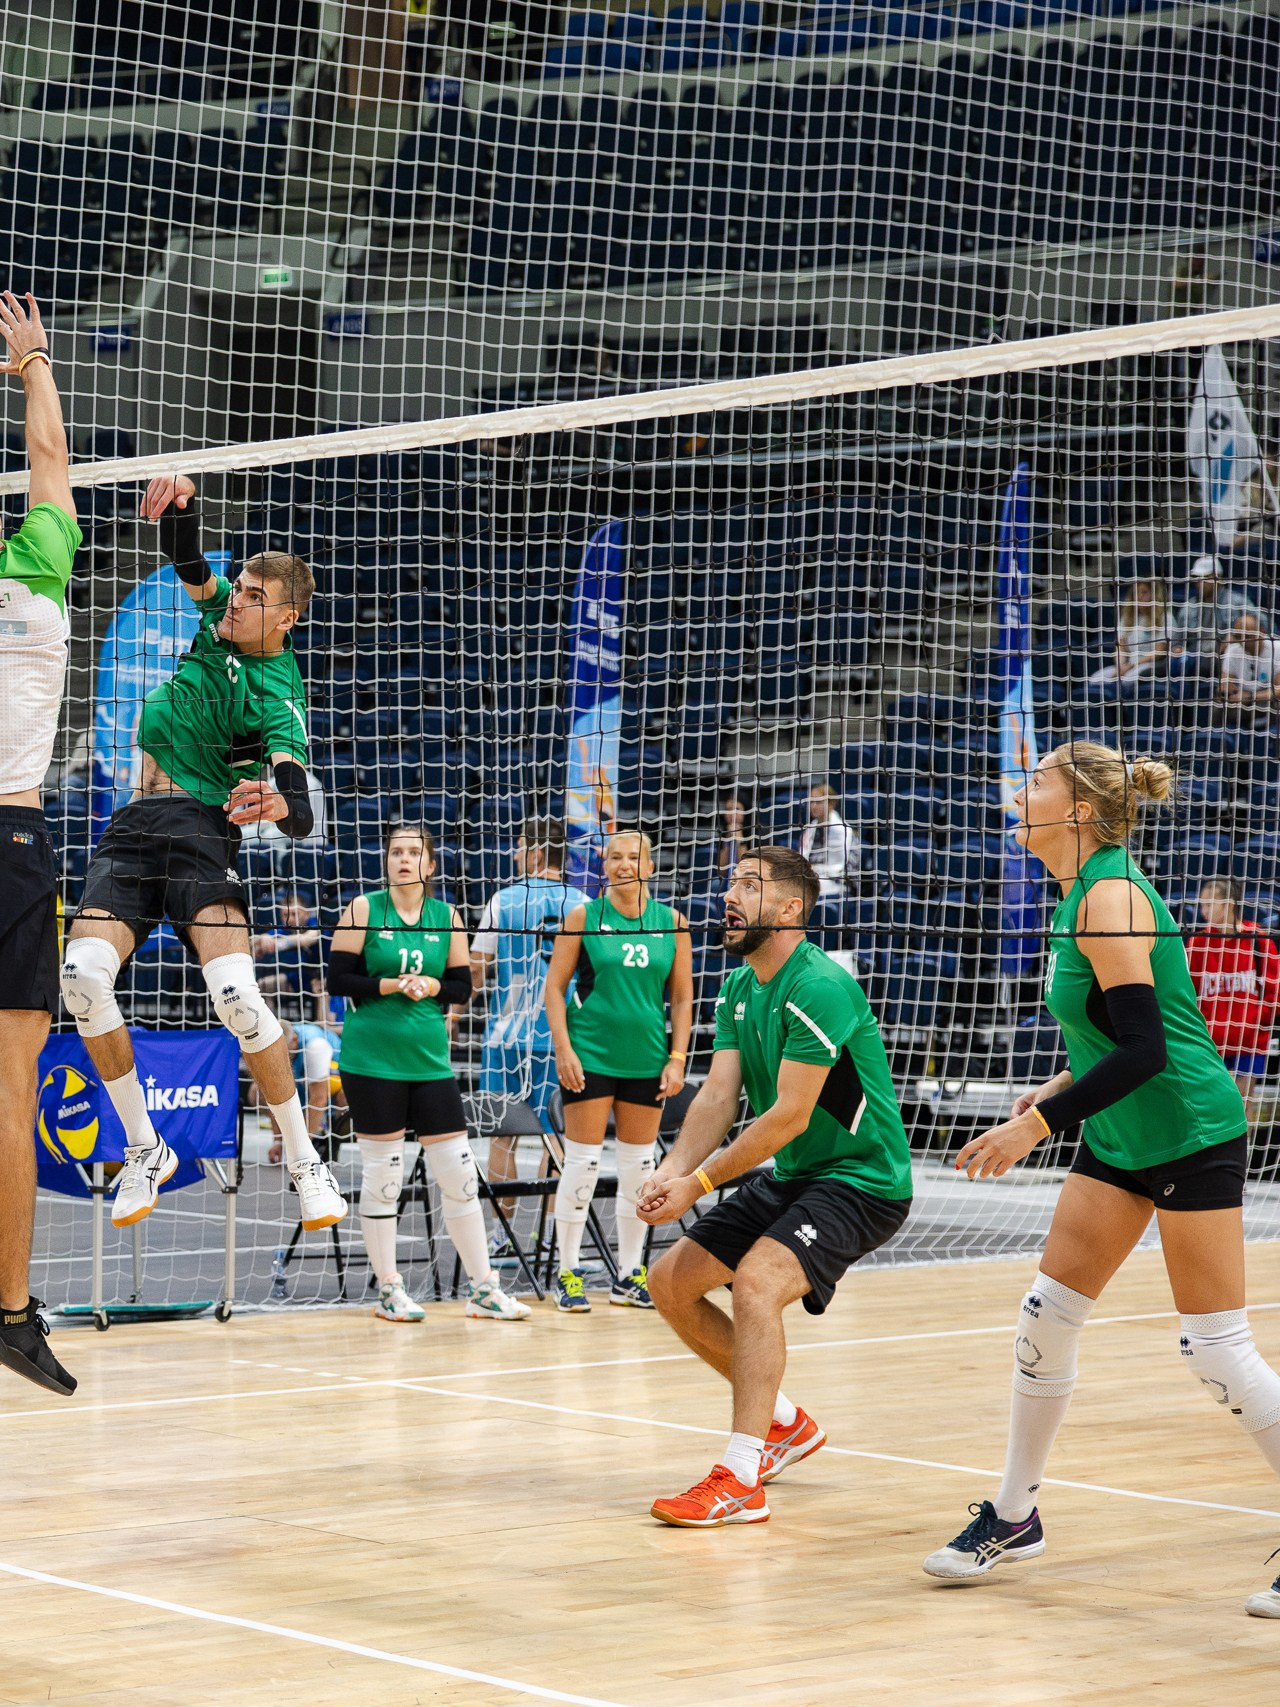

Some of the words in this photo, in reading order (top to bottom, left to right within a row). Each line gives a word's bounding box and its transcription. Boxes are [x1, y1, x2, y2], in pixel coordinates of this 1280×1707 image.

[398, 947, 424, 975] 13
[621, 942, 650, 969] 23
[223, 994, 241, 1005] errea
[140, 1080, 219, 1112] IKASA
[793, 1229, 812, 1247] errea
[4, 1312, 28, 1325] PUMA
[1023, 1304, 1040, 1319] errea
